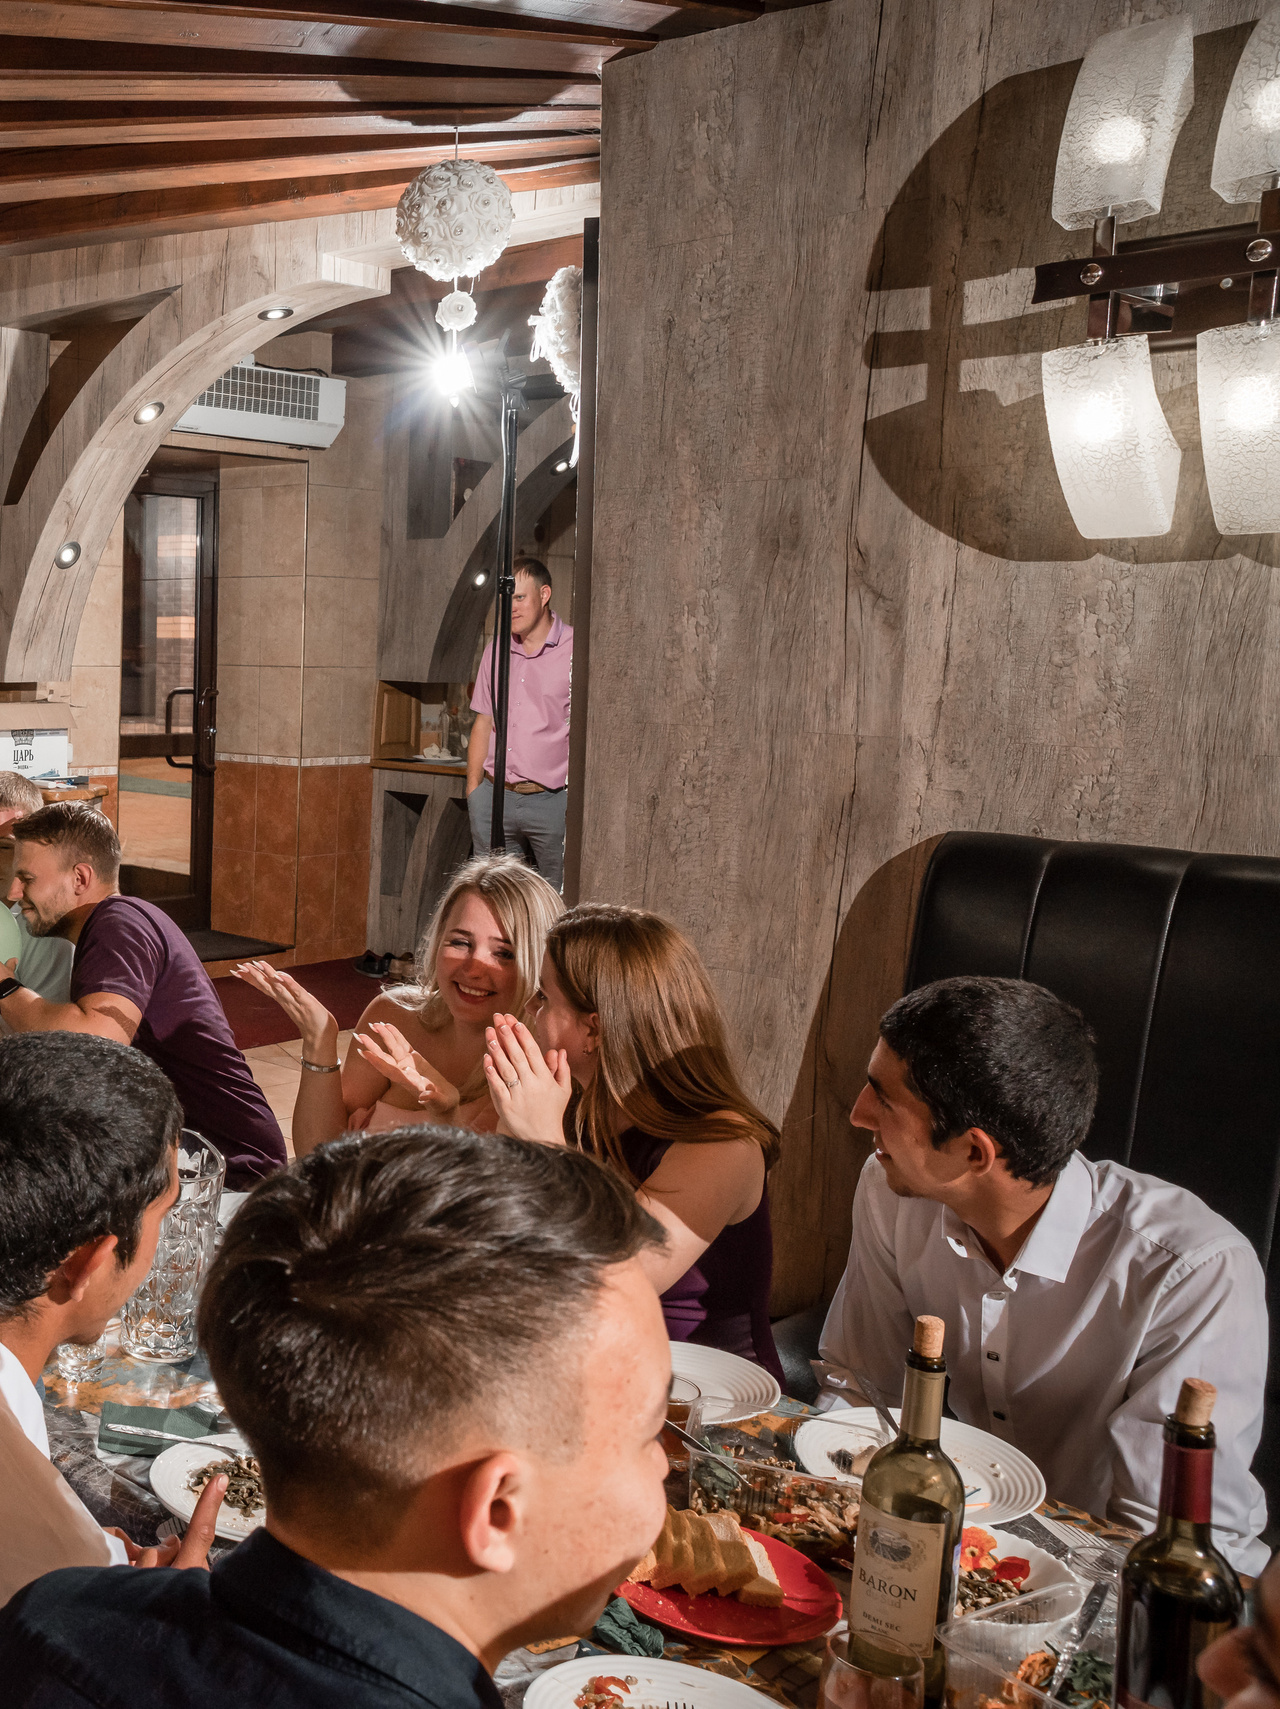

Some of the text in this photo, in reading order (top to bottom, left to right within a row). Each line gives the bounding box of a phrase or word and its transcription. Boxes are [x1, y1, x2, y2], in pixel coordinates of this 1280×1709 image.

[13, 749, 34, 765] ЦАРЬ
[859, 1567, 918, 1602] BARON
[862, 1611, 901, 1632] DEMI SEC
